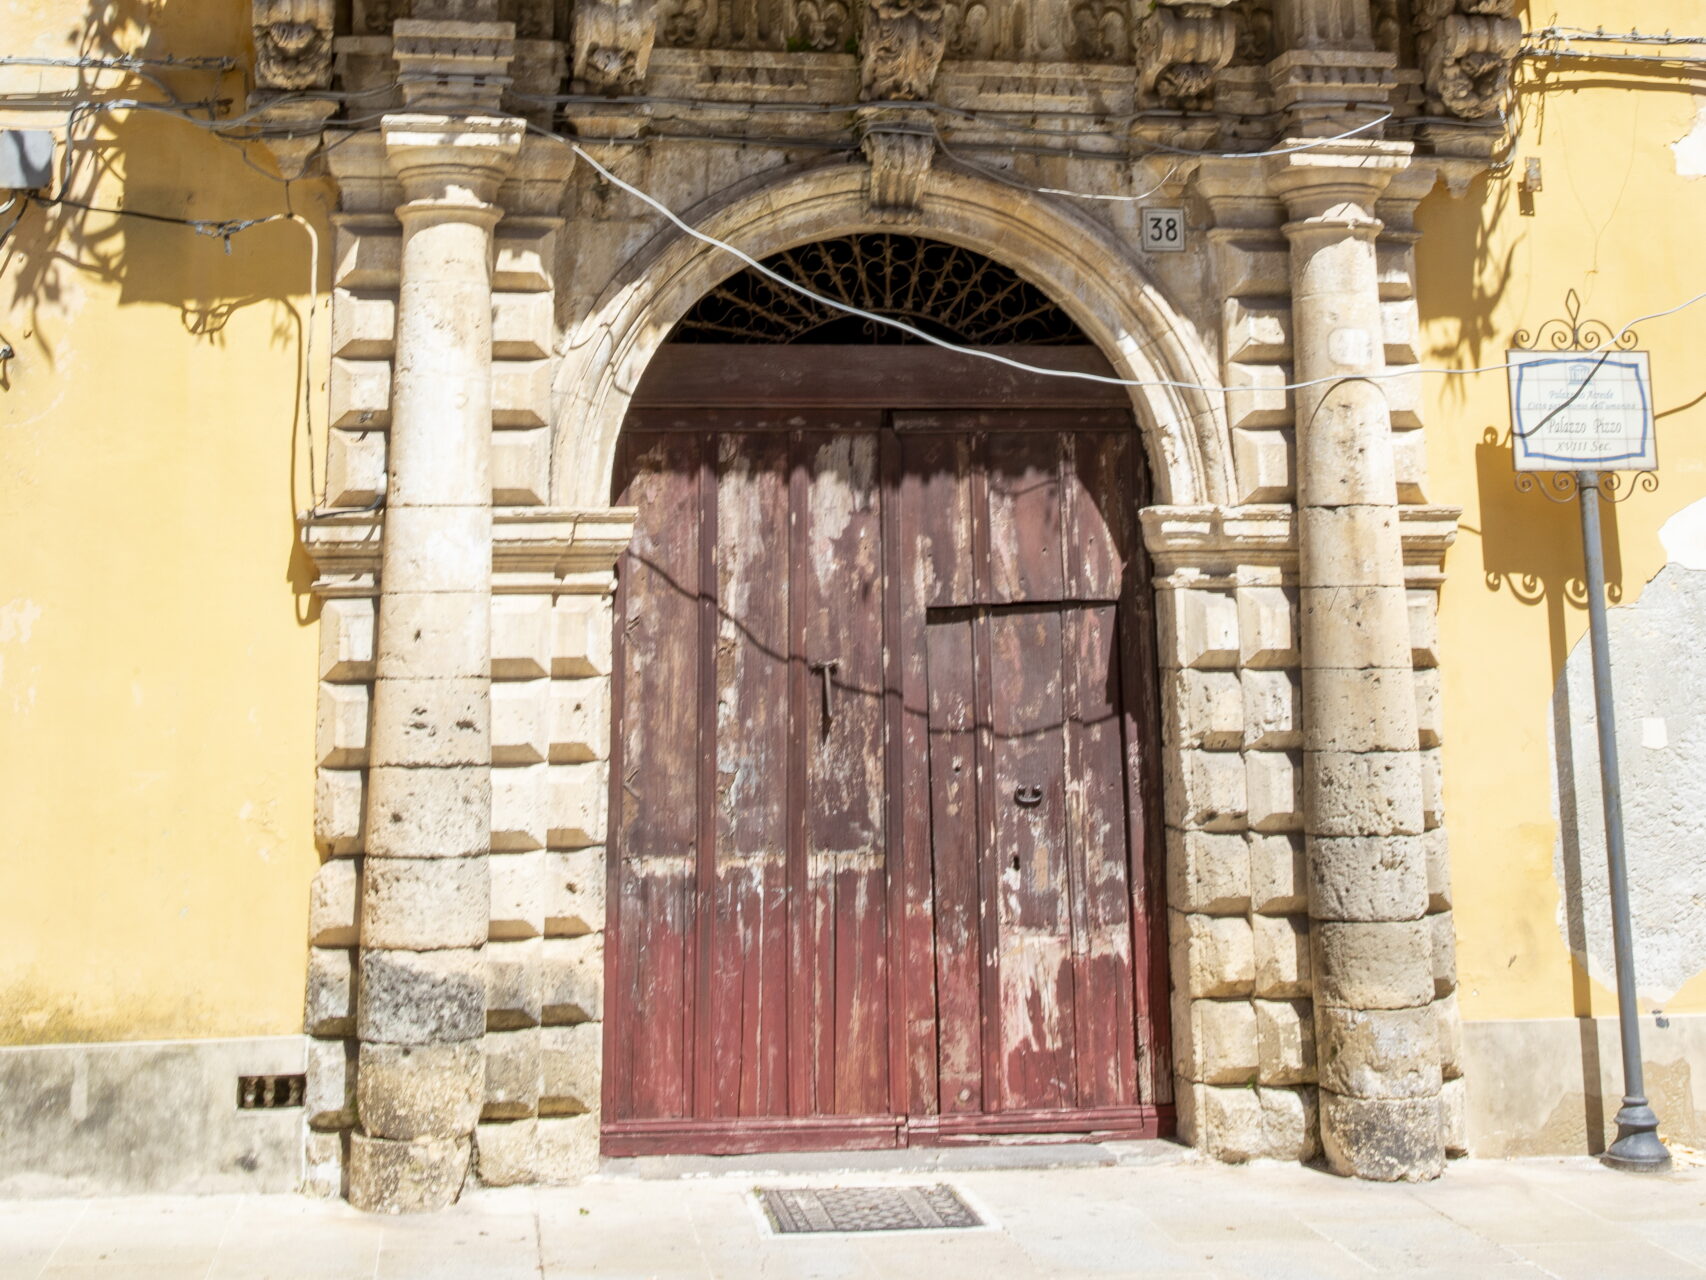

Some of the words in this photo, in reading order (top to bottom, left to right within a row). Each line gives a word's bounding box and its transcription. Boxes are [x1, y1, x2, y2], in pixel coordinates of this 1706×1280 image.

[1149, 216, 1178, 242] 38
[1547, 416, 1586, 434] Palazzo
[1593, 417, 1622, 434] Pizzo
[1554, 440, 1587, 453] XVIII
